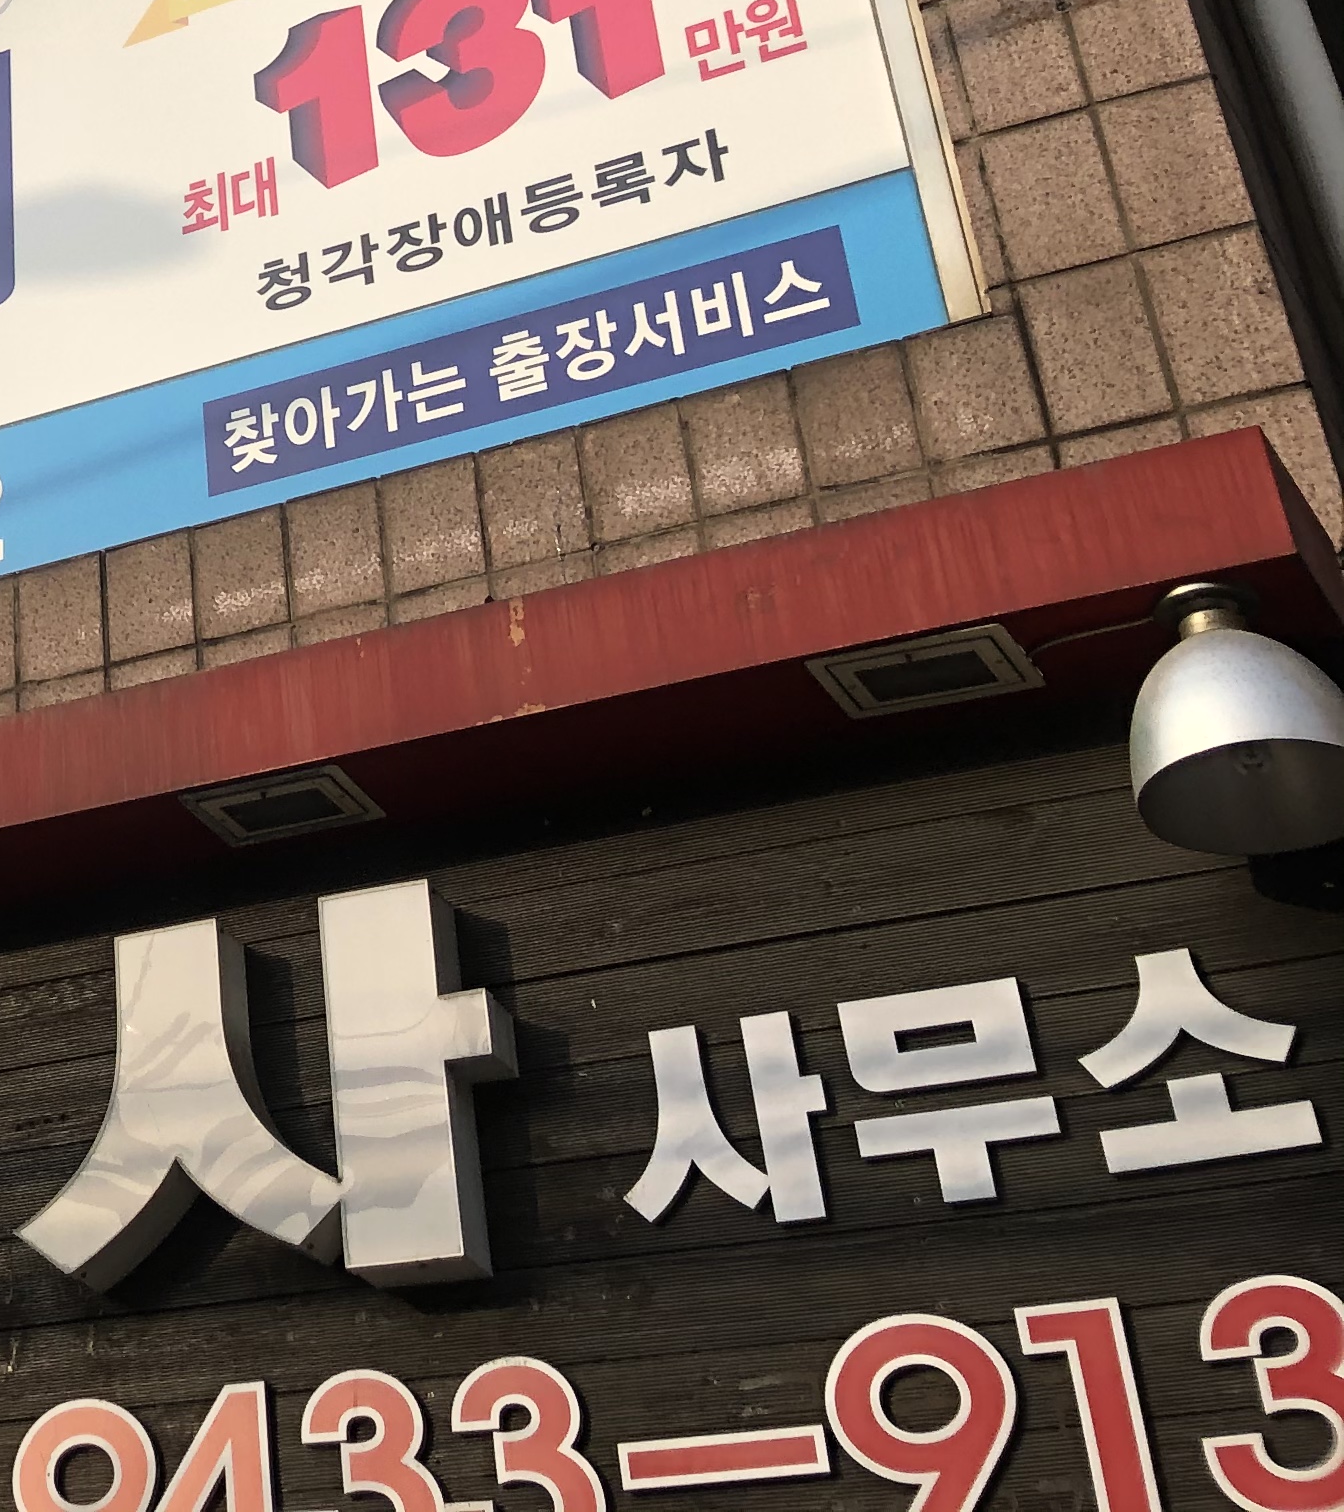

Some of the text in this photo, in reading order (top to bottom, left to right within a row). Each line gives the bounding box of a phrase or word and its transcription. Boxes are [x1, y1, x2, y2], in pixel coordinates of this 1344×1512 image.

[181, 155, 281, 235] 최대
[255, 128, 731, 313] 청각장애등록자
[222, 258, 832, 475] 찾아가는 출장서비스
[623, 946, 1324, 1227] 사무소
